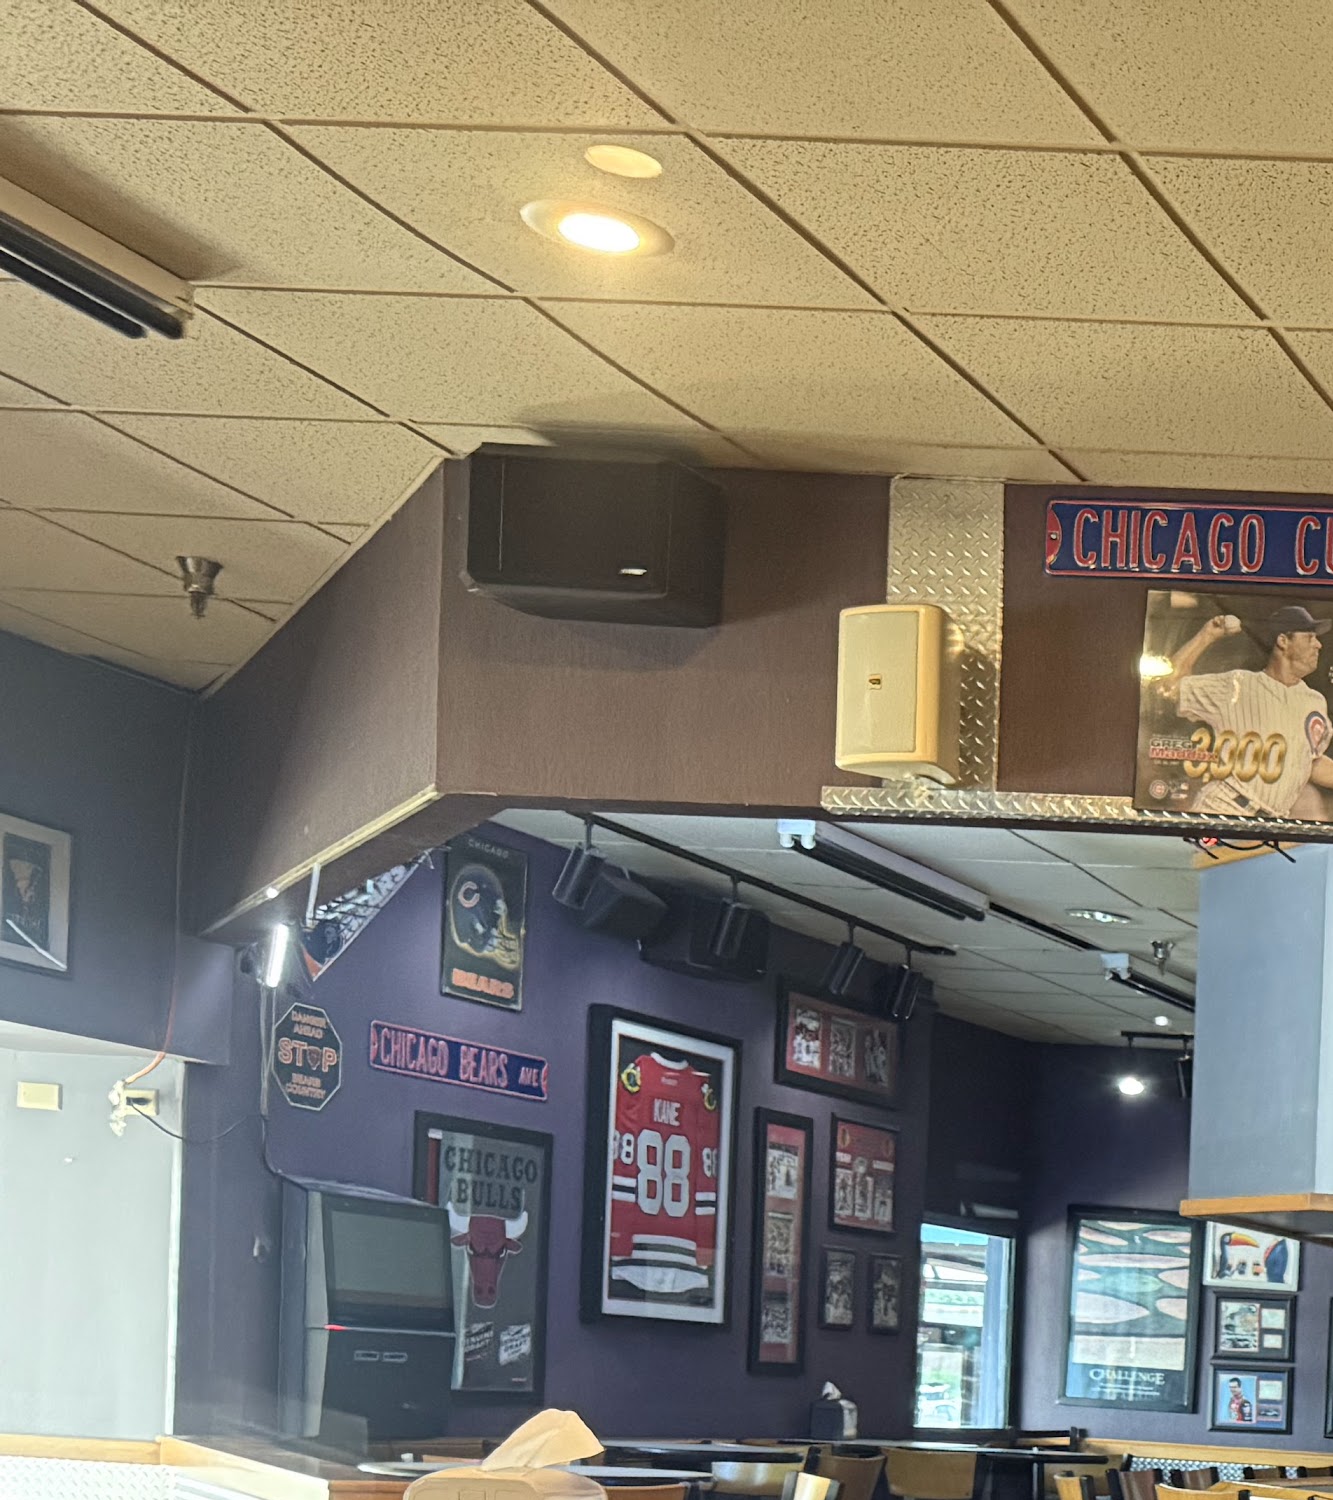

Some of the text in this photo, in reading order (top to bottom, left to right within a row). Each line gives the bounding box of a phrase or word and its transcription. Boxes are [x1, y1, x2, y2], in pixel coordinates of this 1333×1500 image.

[1073, 508, 1266, 574] CHICAGO
[1151, 738, 1192, 749] GREG
[1183, 727, 1287, 784] 3,000
[468, 838, 509, 860] CHICAGO
[452, 967, 515, 999] BEARS
[278, 1037, 337, 1072] STOP
[380, 1027, 539, 1088] CHICAGO BEARS AVE
[654, 1098, 680, 1126] KANE
[444, 1146, 538, 1184] CHICAGO
[636, 1129, 691, 1217] 88
[457, 1178, 523, 1211] BULLS
[1089, 1368, 1165, 1385] CHALLENGE
